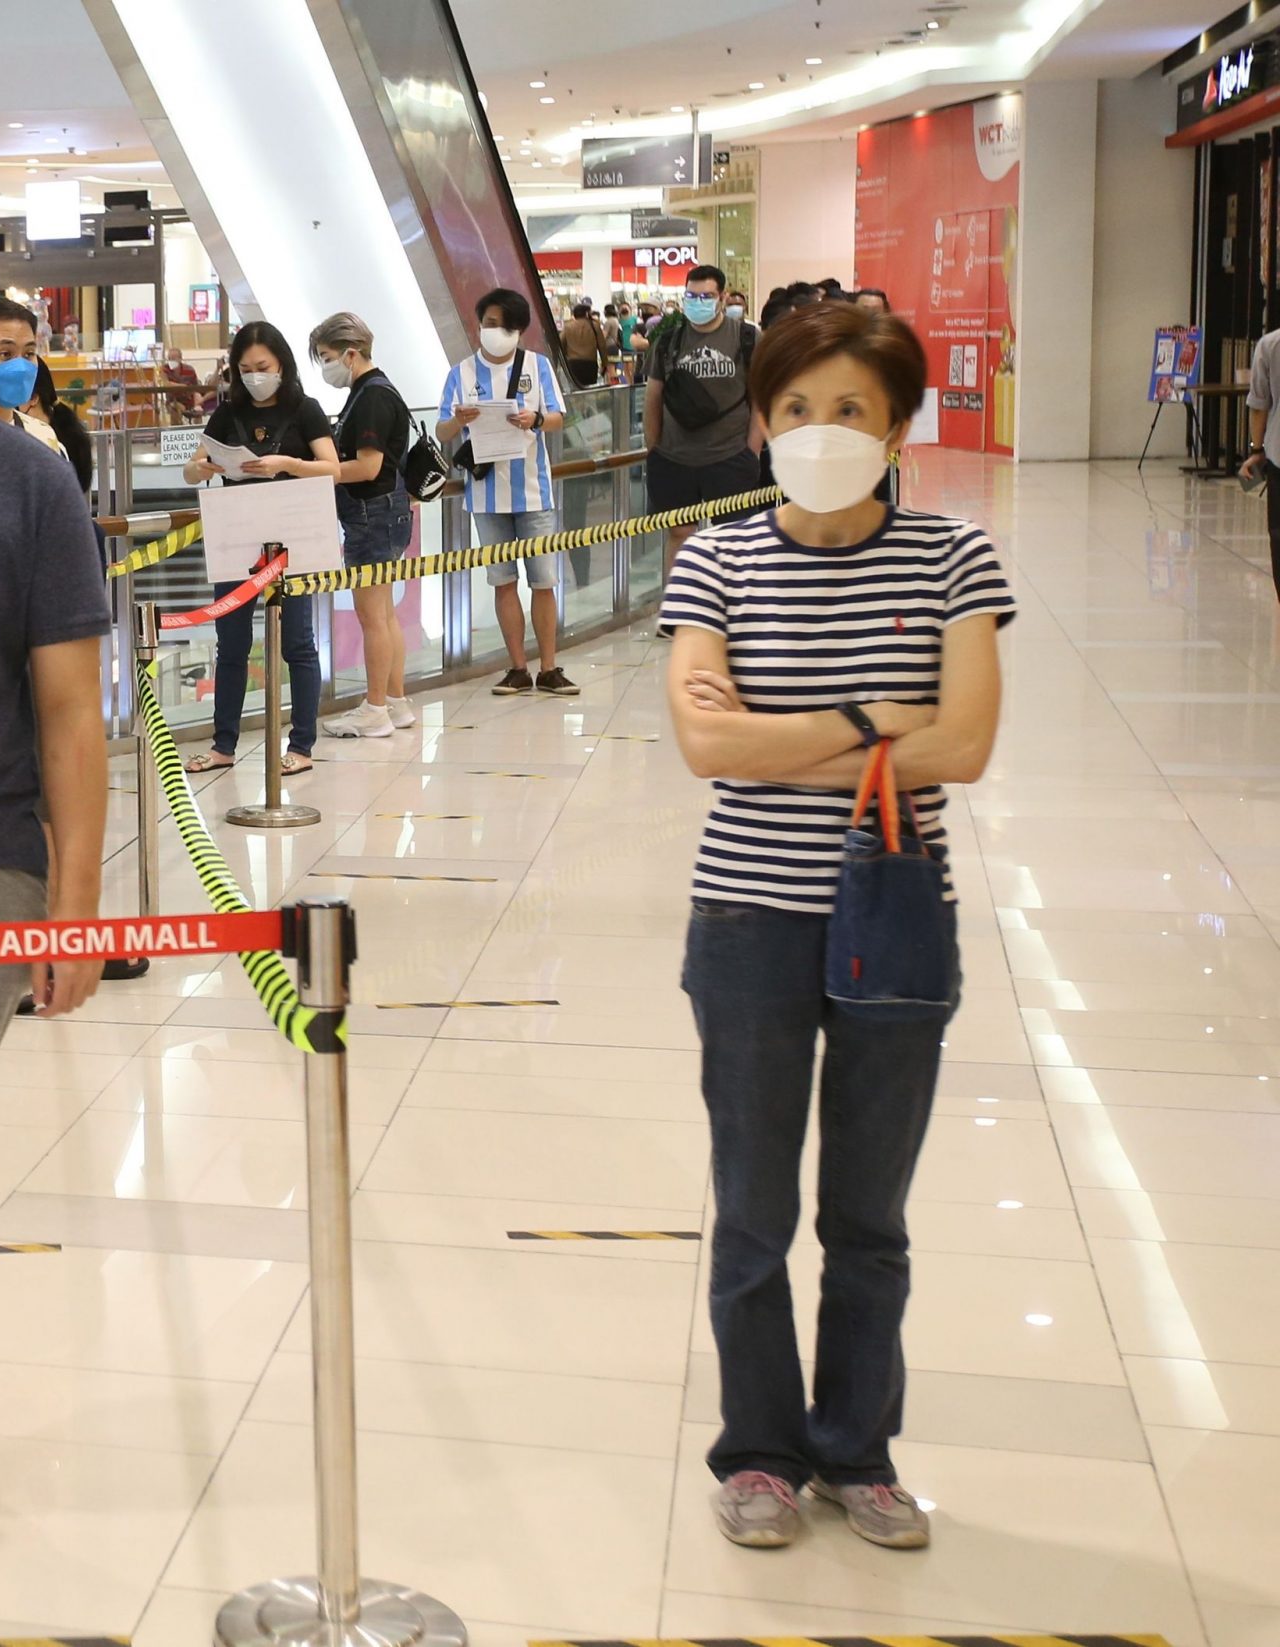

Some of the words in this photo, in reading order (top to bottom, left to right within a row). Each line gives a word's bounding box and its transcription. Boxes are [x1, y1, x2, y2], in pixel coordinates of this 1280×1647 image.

[163, 434, 184, 442] PLEASE
[186, 433, 194, 441] DO
[163, 453, 172, 461] SIT
[173, 453, 183, 461] ON
[124, 922, 217, 951] MALL
